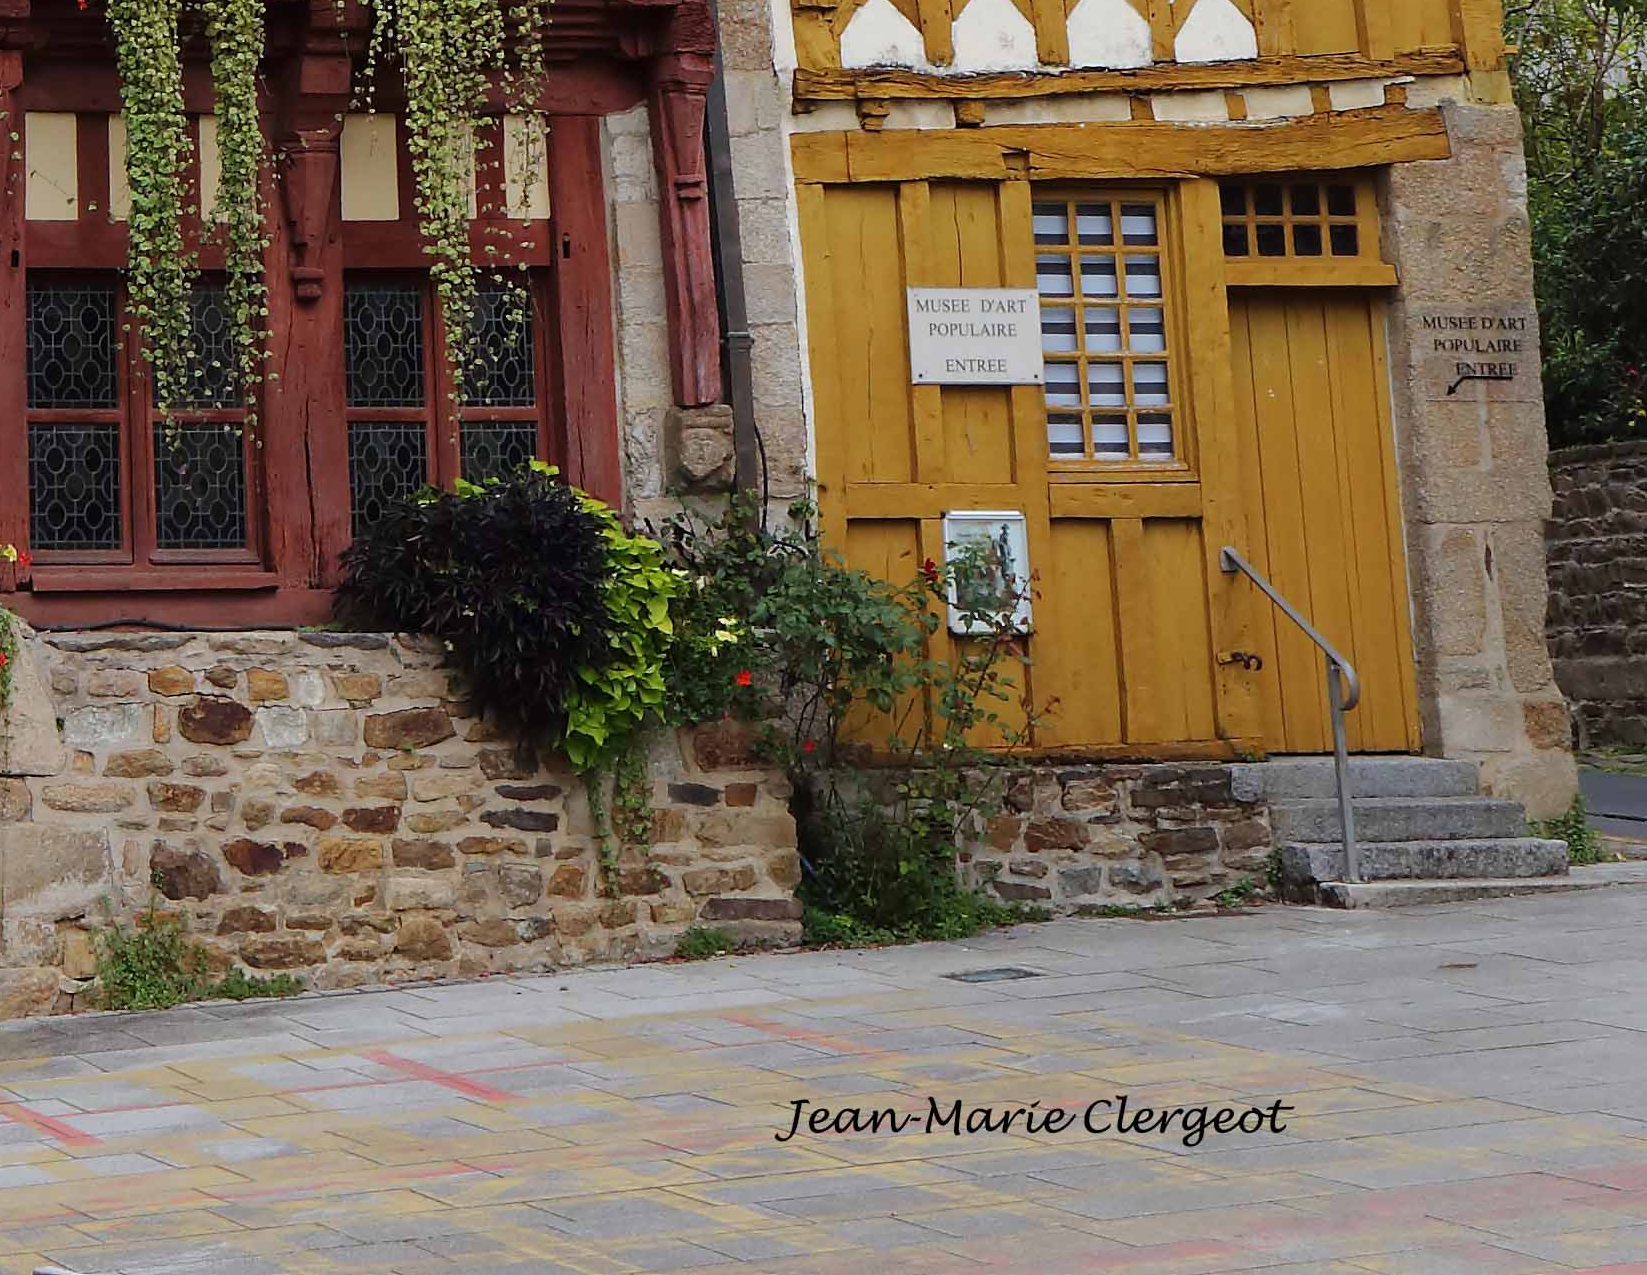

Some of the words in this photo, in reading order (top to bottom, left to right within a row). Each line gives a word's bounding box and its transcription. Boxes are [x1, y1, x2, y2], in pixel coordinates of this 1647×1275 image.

[916, 298, 971, 313] MUSEE
[980, 298, 1027, 313] D'ART
[929, 322, 1018, 337] POPULAIRE
[1423, 316, 1477, 330] MUSEE
[1482, 317, 1526, 331] D'ART
[1434, 338, 1522, 352] POPULAIRE
[945, 358, 1007, 372] ENTREE
[1456, 362, 1517, 375] ENTREE
